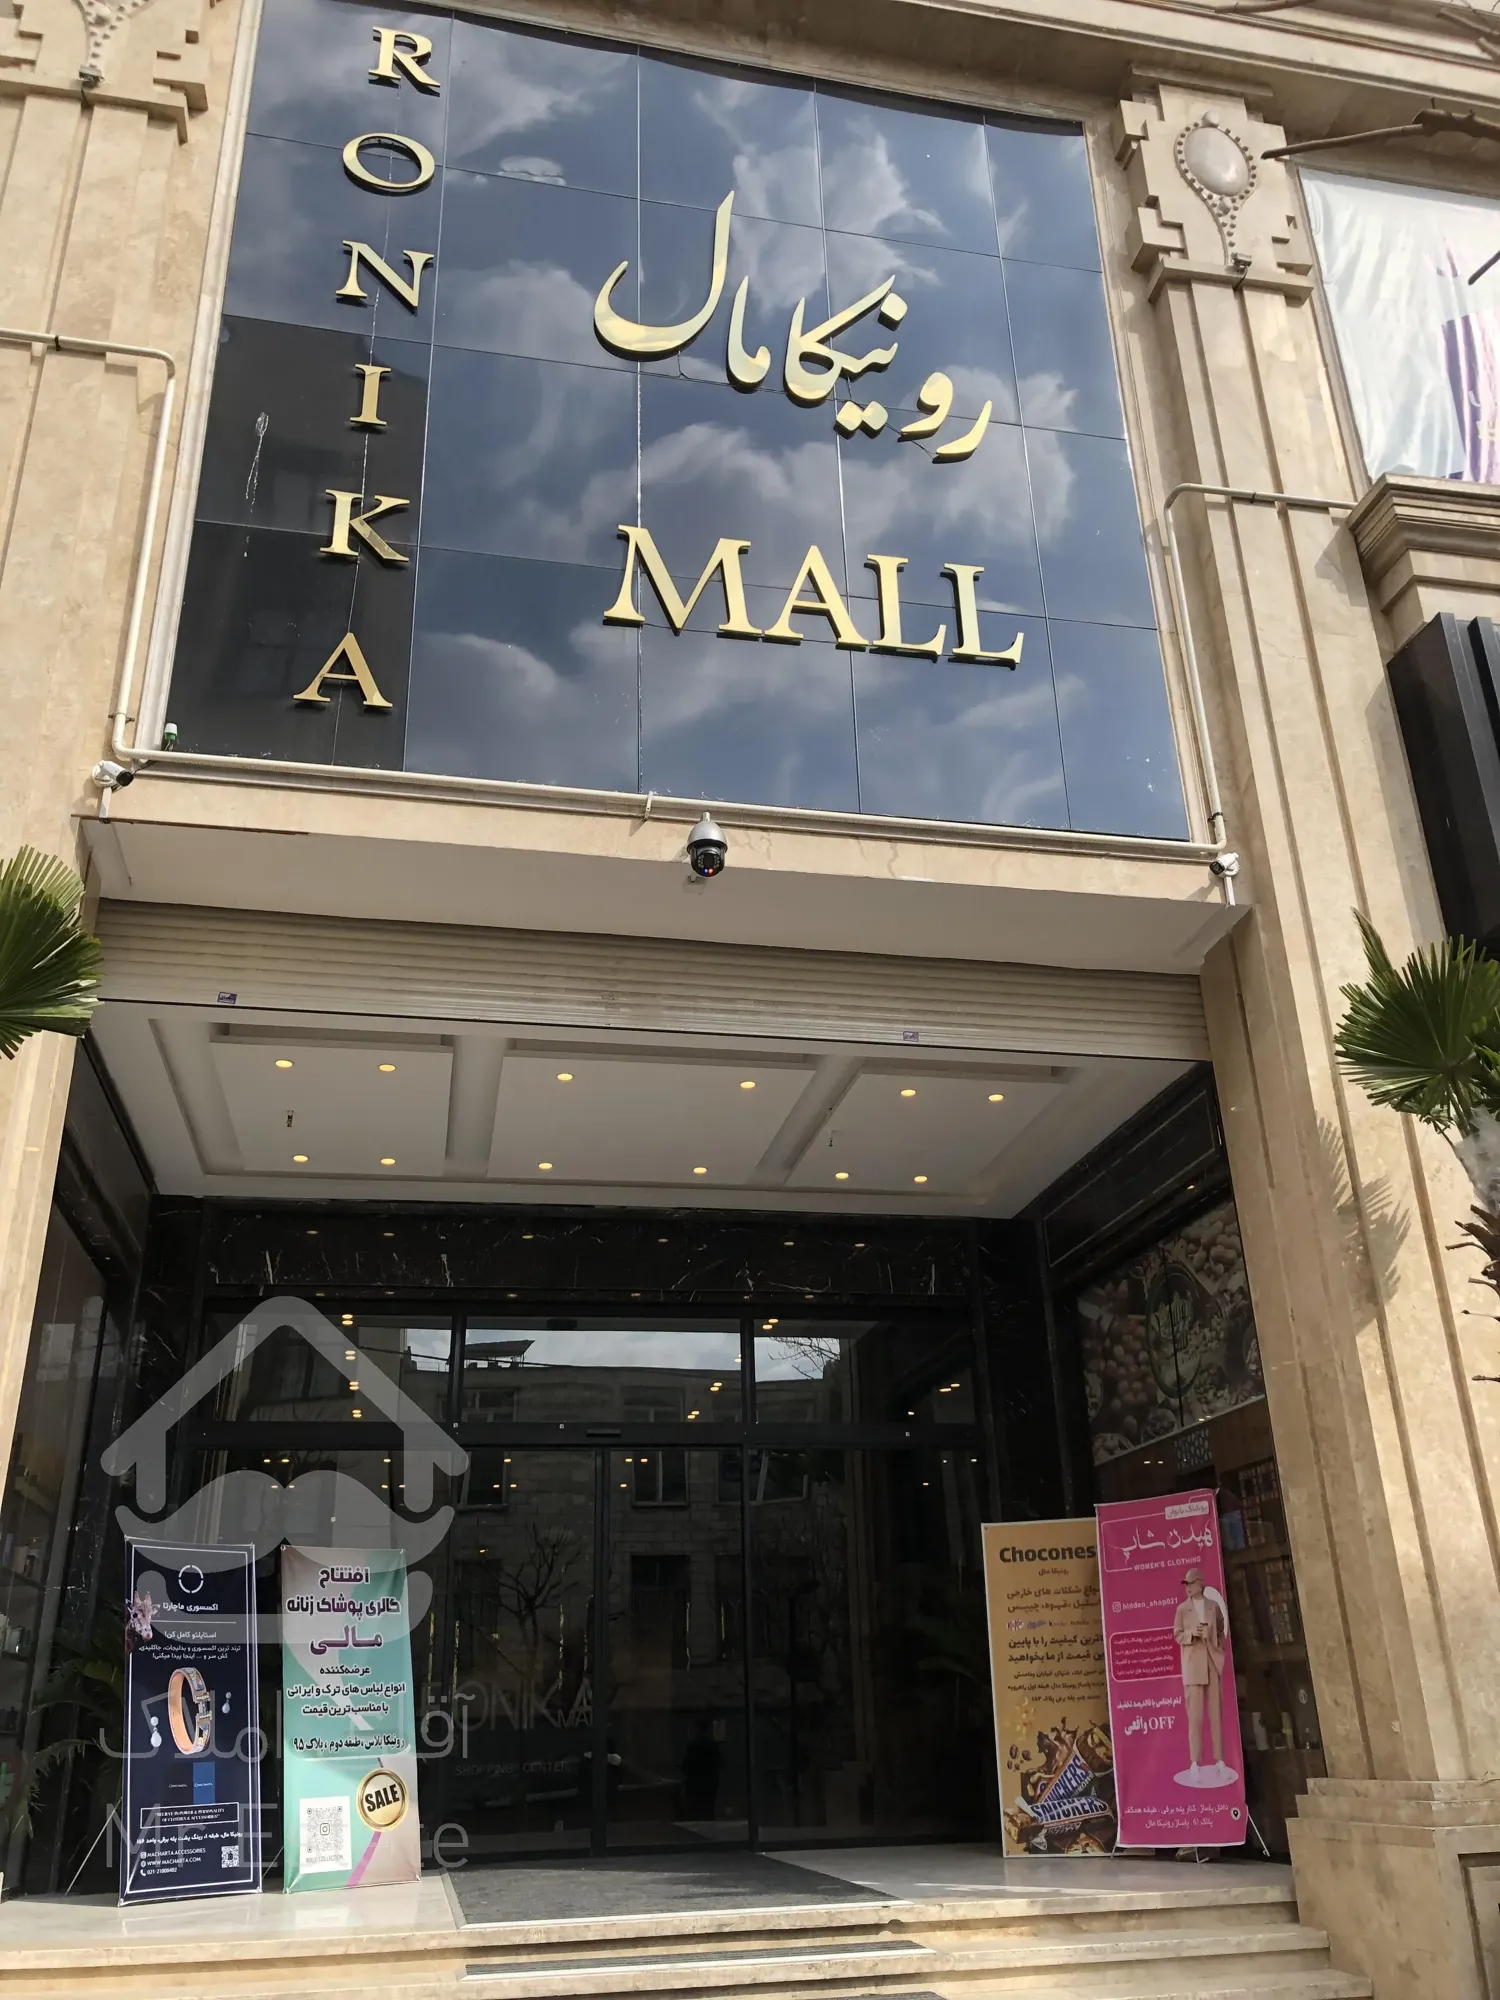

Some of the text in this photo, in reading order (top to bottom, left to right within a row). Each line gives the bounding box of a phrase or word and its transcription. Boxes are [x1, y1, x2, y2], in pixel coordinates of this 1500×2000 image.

[594, 190, 992, 460] رونیکا مال
[292, 25, 441, 711] RONIKA
[603, 525, 1024, 667] MALL
[999, 1546, 1097, 1563] Chocones
[1168, 1556, 1200, 1567] CLOTHING
[286, 1596, 314, 1616] زنانه
[316, 1593, 363, 1621] پوشاک
[310, 1624, 383, 1656] مالی
[287, 1685, 314, 1698] ایرانی
[322, 1685, 340, 1696] ترک
[342, 1684, 359, 1697] های
[360, 1683, 384, 1696] لباس
[383, 1683, 406, 1698] انواع
[302, 1705, 328, 1717] قیمت
[1148, 1716, 1176, 1730] OFF
[365, 1784, 400, 1813] SALE
